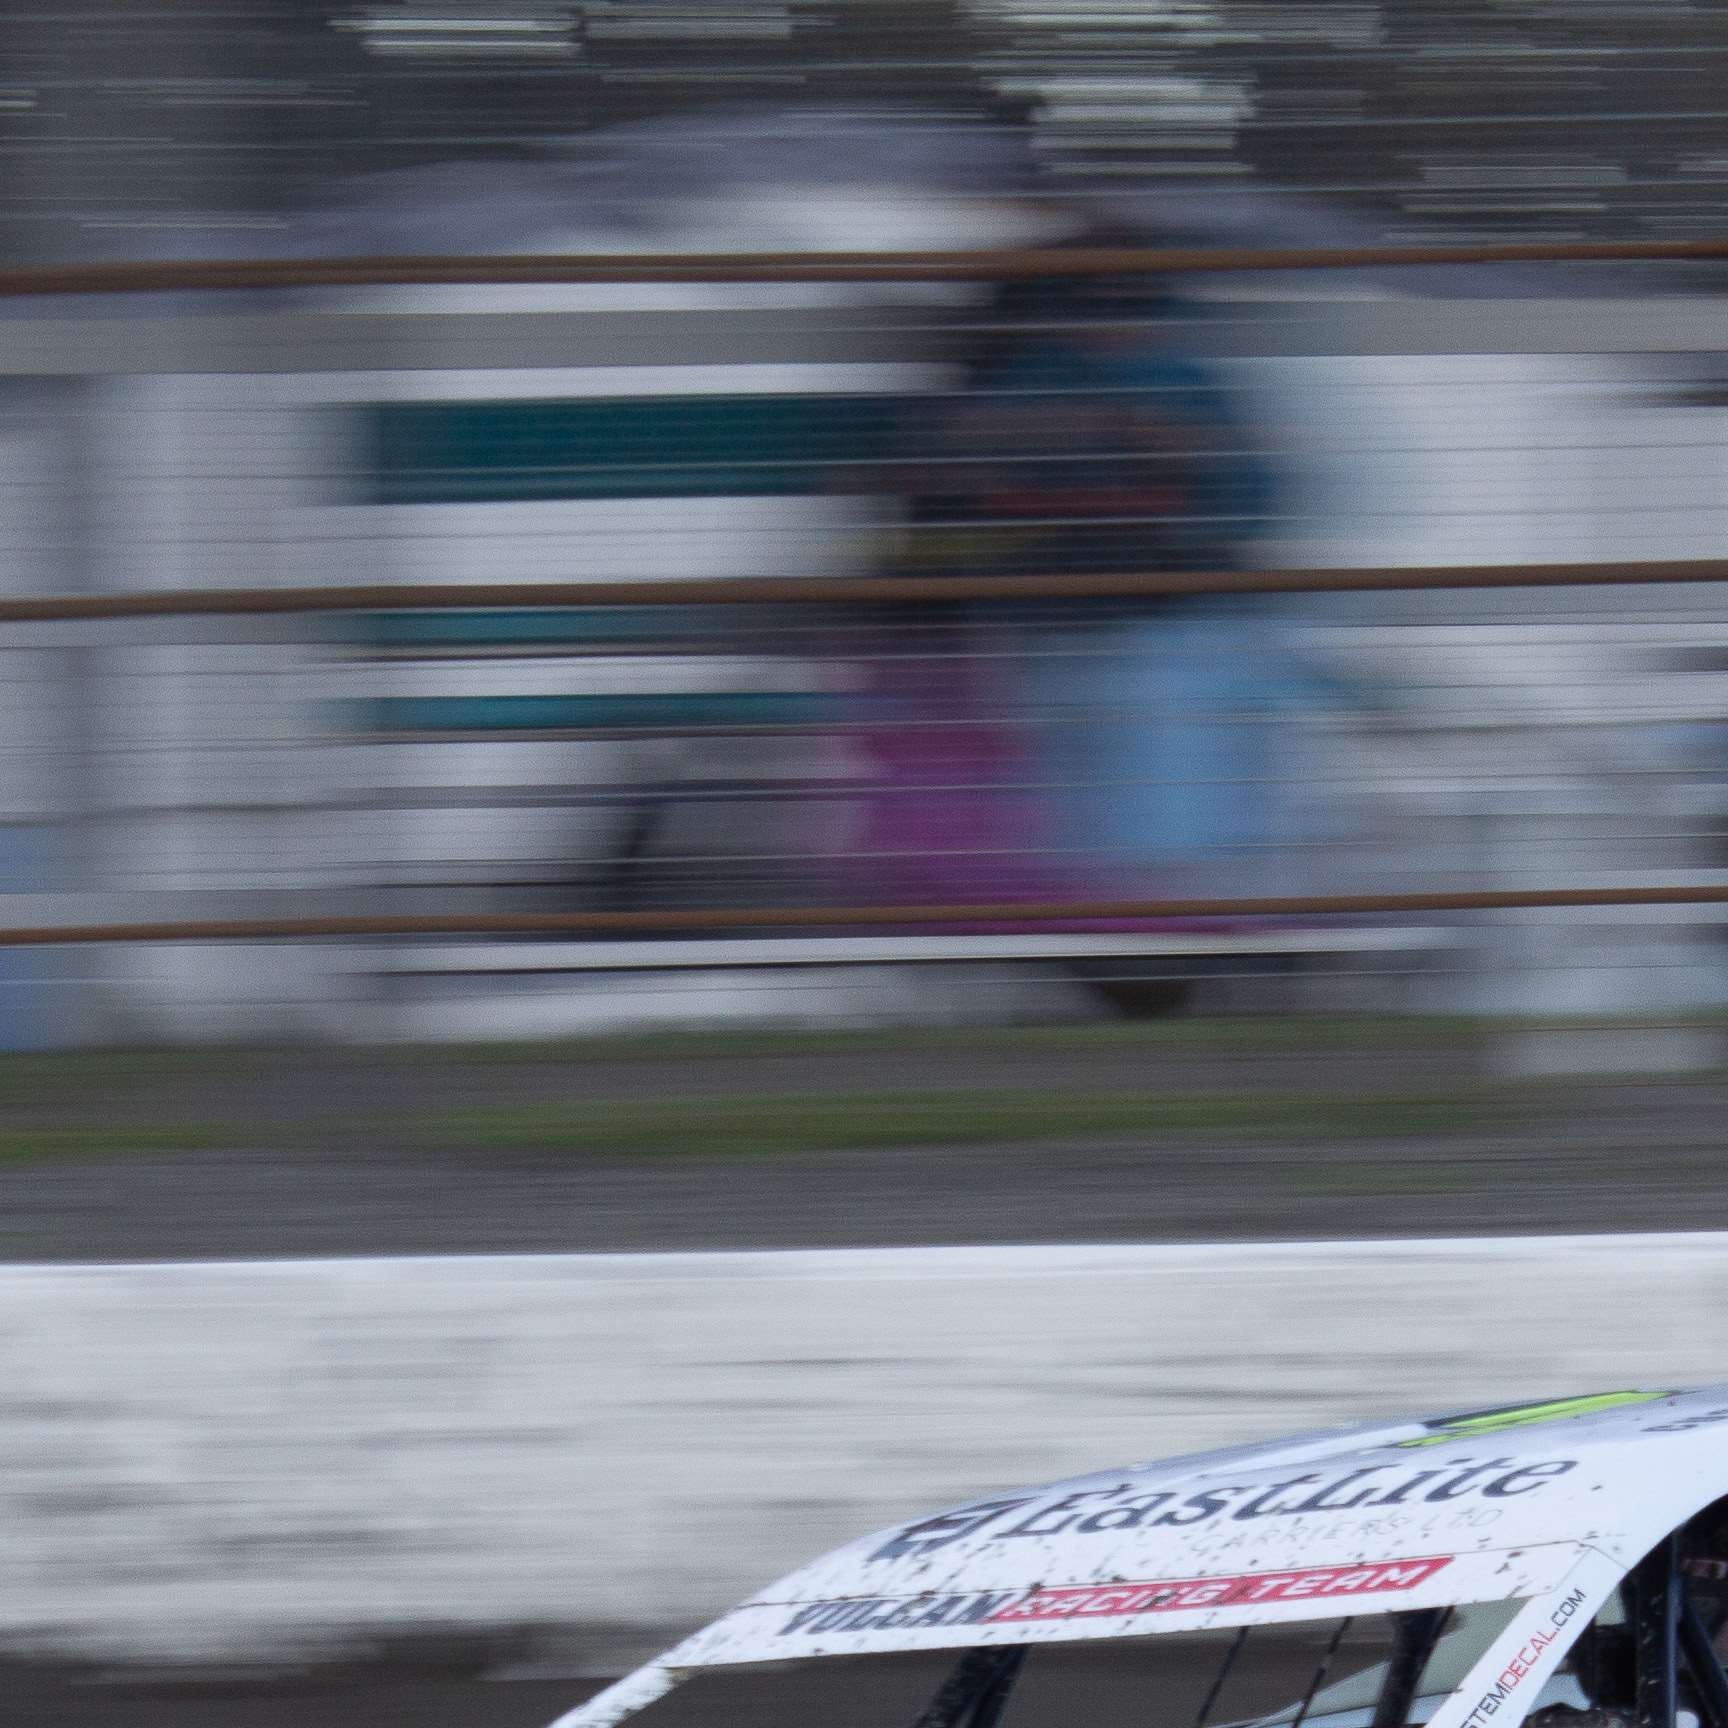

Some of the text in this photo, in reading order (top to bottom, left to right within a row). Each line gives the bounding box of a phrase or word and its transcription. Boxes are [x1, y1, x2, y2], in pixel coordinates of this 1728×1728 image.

[992, 1457, 1579, 1541] EastLite
[776, 1565, 1432, 1636] VULCAN RACING TEAM
